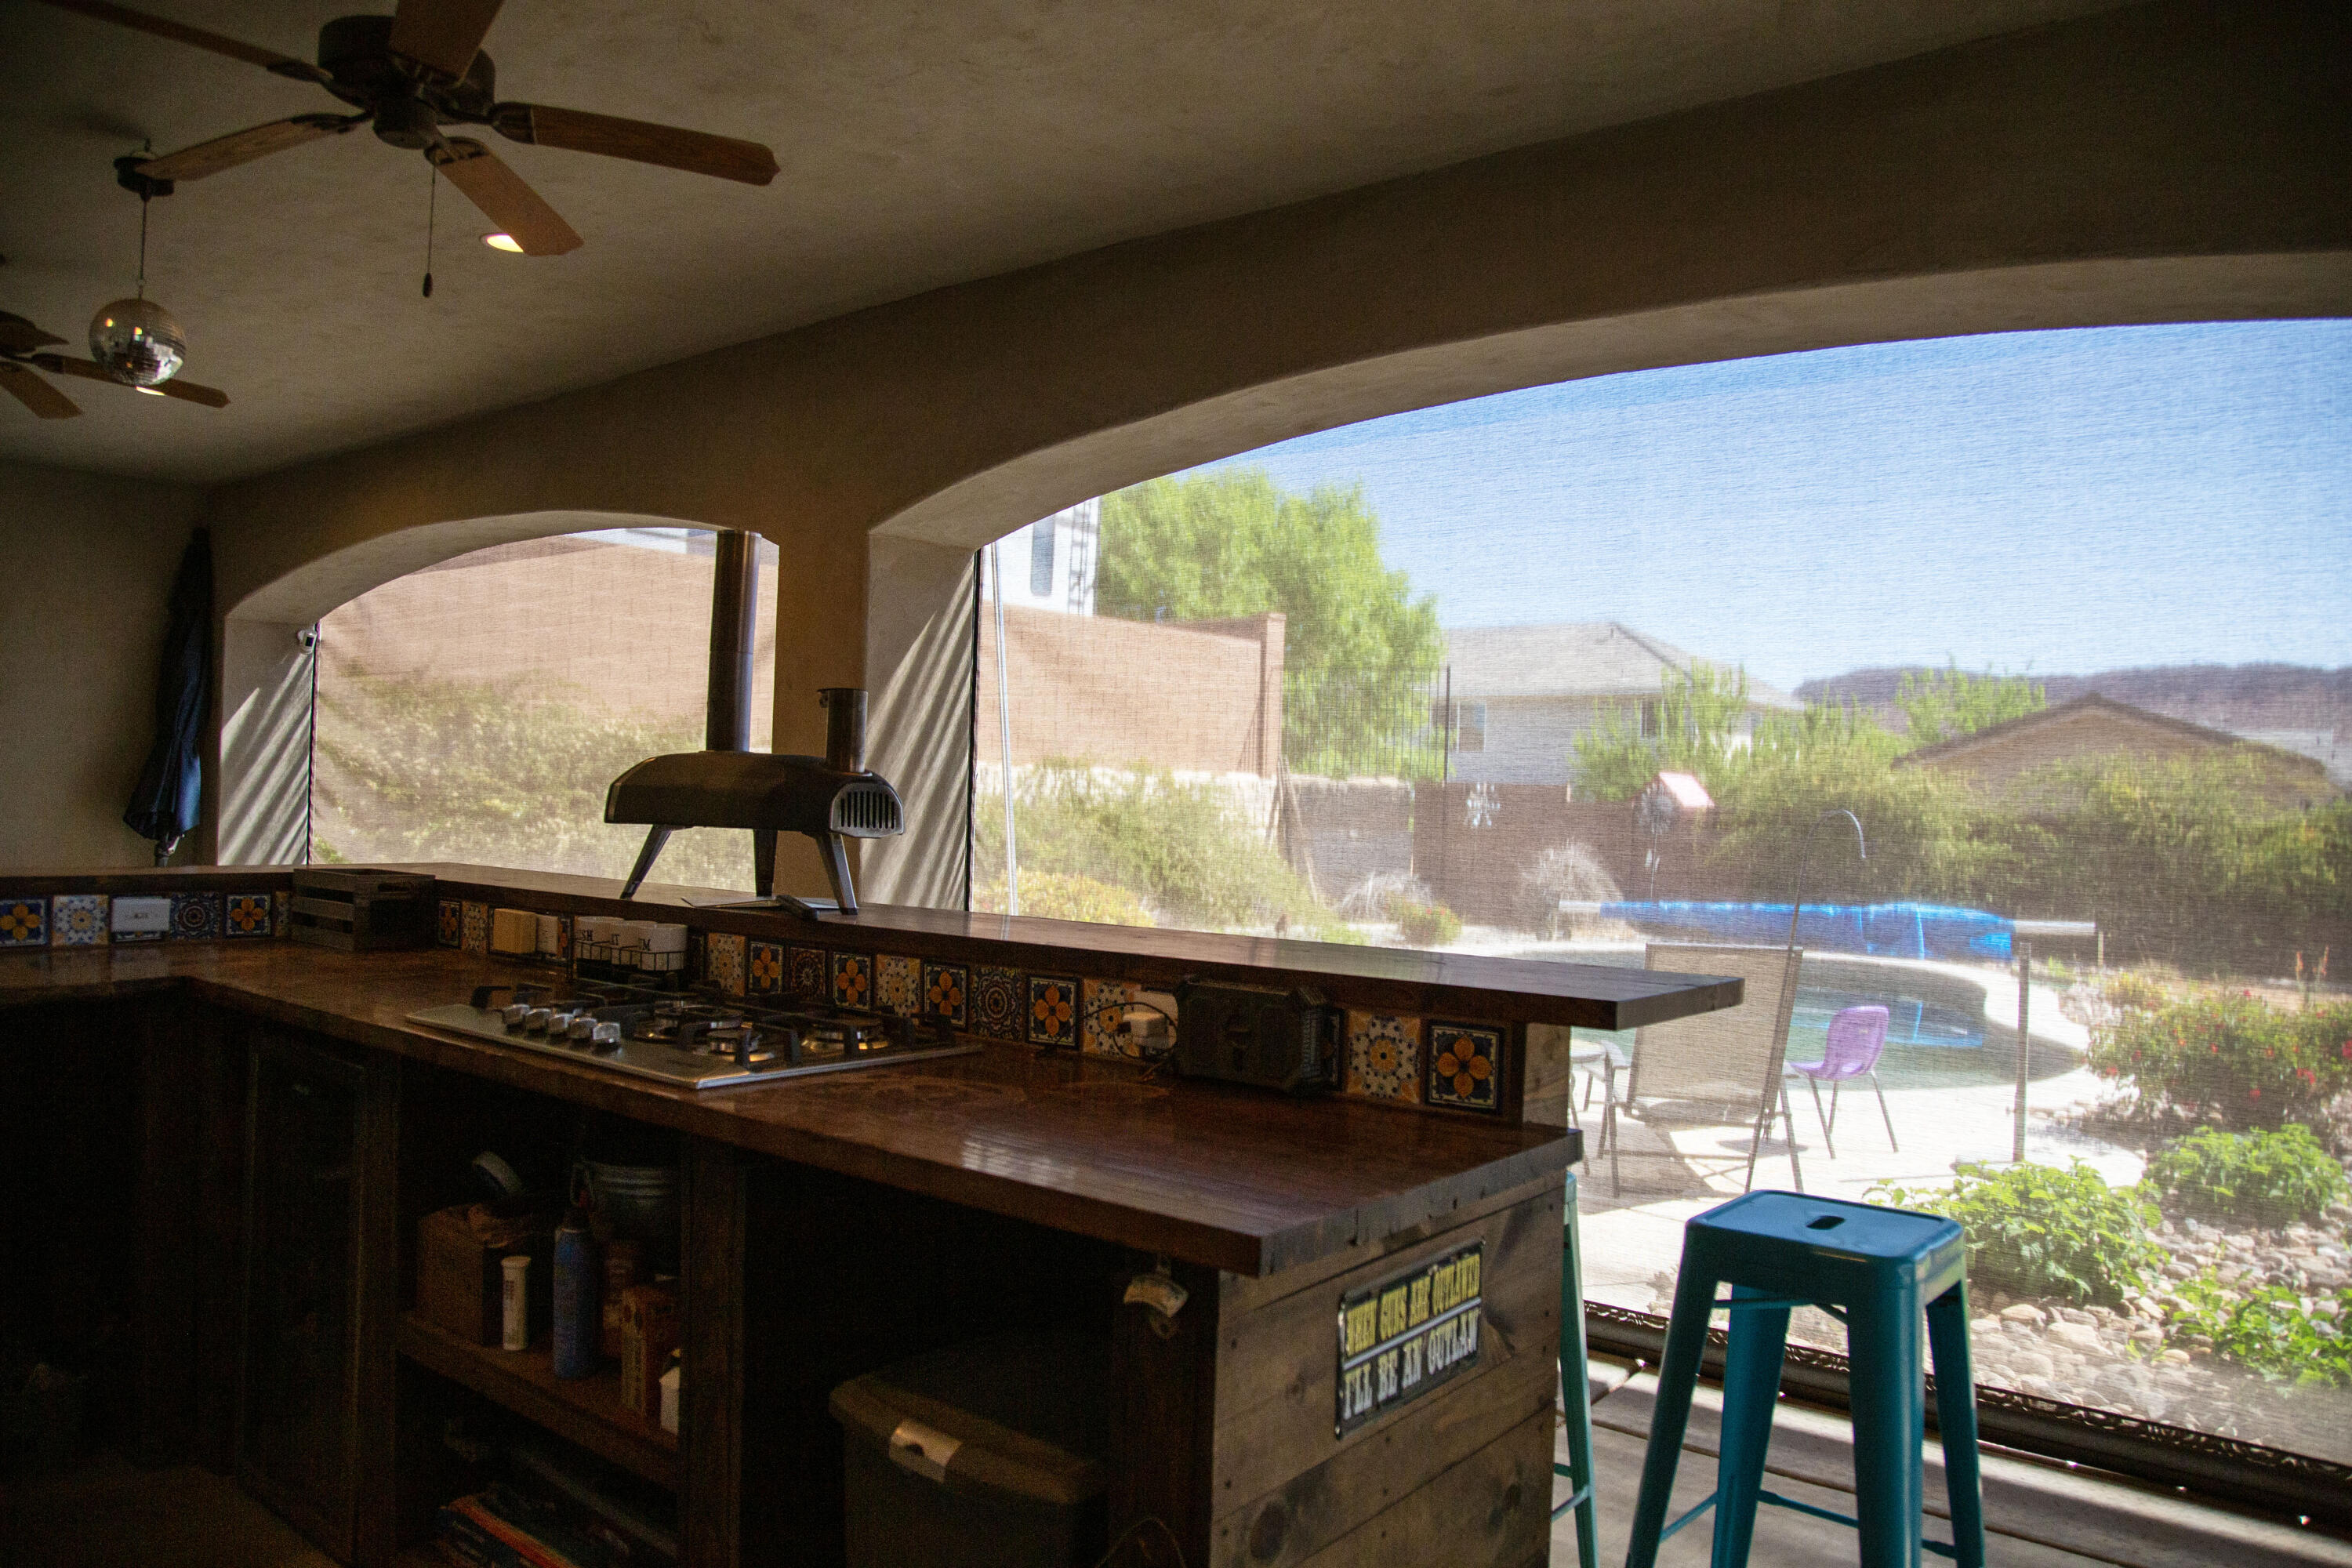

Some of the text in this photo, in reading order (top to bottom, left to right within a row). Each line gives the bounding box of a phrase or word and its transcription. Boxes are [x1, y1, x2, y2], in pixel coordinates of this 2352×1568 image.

[1345, 1253, 1481, 1358] WHEN GUNS ARE OUTLAWED
[1343, 1305, 1481, 1420] I'LL BE AN OUTLAW
